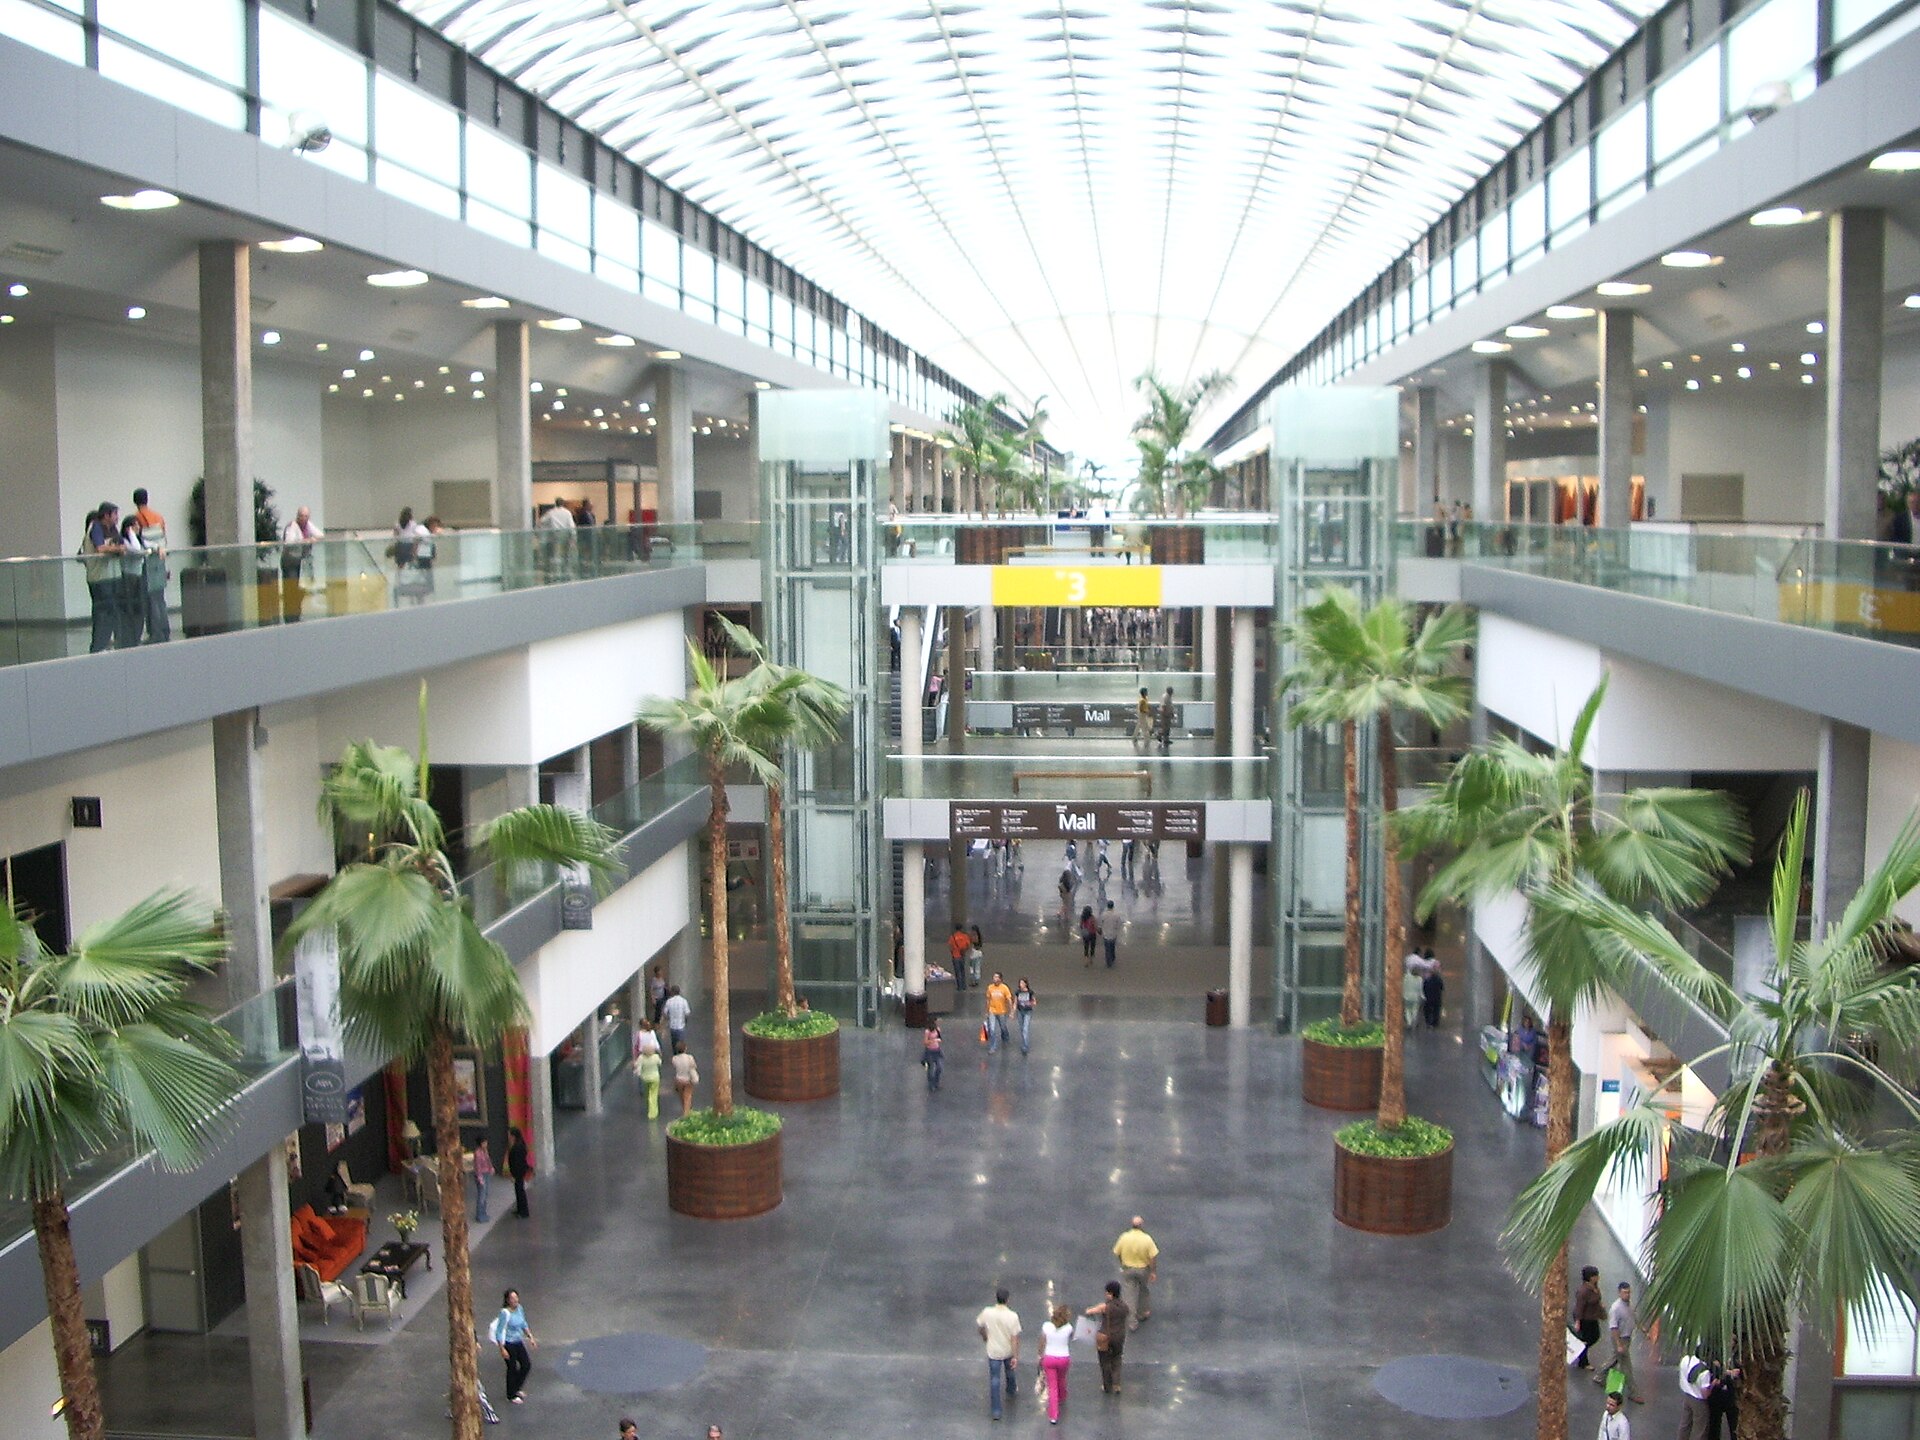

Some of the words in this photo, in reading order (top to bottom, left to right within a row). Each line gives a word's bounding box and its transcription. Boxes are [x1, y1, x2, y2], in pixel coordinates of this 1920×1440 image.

[1067, 571, 1086, 601] 3
[1085, 709, 1110, 721] Mall
[1059, 812, 1096, 830] Mall
